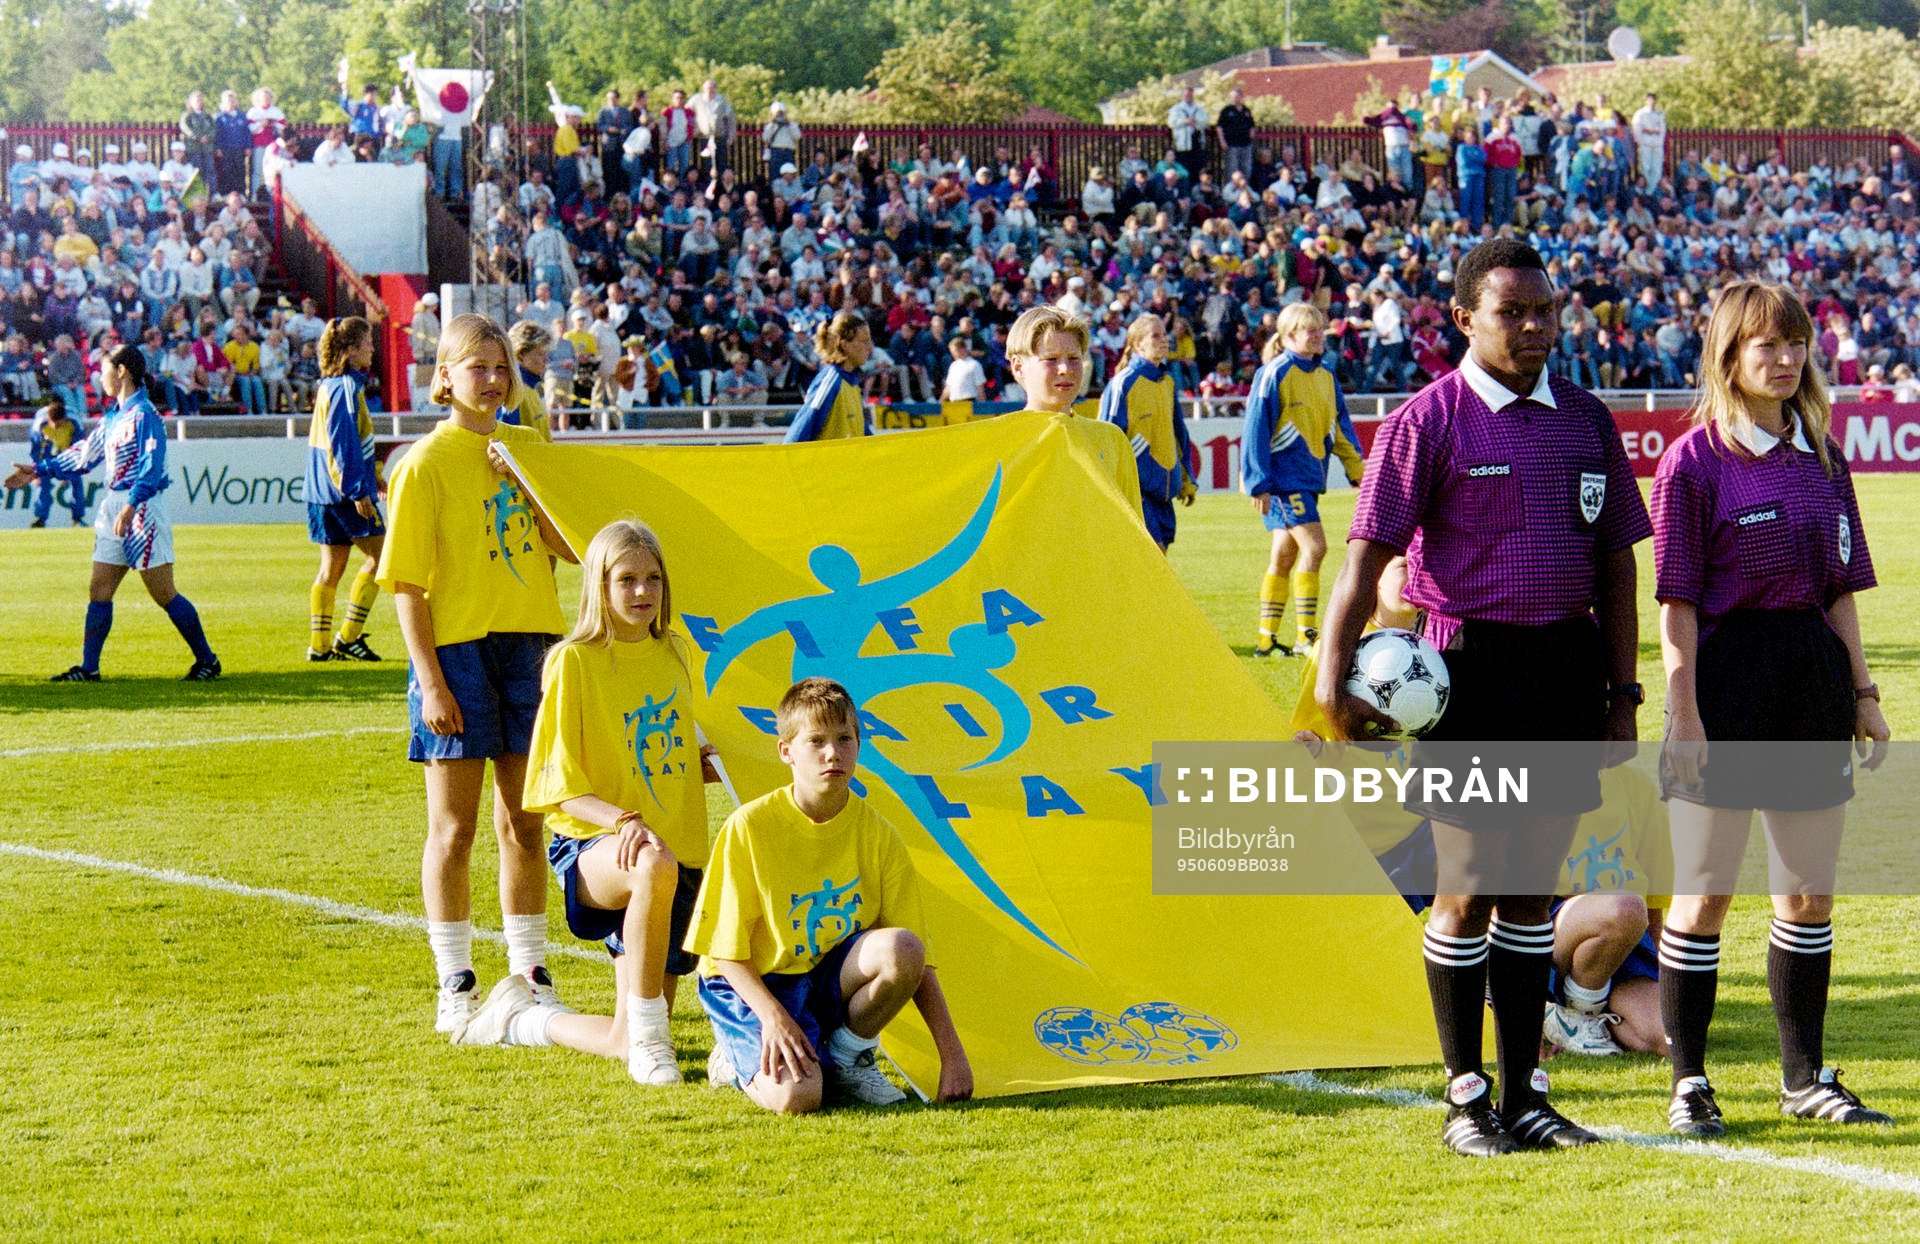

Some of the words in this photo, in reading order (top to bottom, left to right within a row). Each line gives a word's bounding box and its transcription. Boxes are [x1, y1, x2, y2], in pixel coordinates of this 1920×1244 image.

[1621, 430, 1665, 460] EO
[1469, 464, 1511, 477] adidas
[182, 465, 304, 505] Wome
[1288, 494, 1306, 516] 5
[1739, 509, 1777, 526] adidas
[489, 541, 533, 561] PLA
[680, 588, 1046, 659] FIFA
[623, 709, 680, 724] FIFA
[737, 685, 1116, 742] FAIR
[848, 762, 1169, 819] LAY
[1566, 847, 1625, 869] FIFA
[1573, 870, 1635, 893] FAIR
[790, 893, 863, 907] FIFA
[1451, 1078, 1482, 1096] adidas
